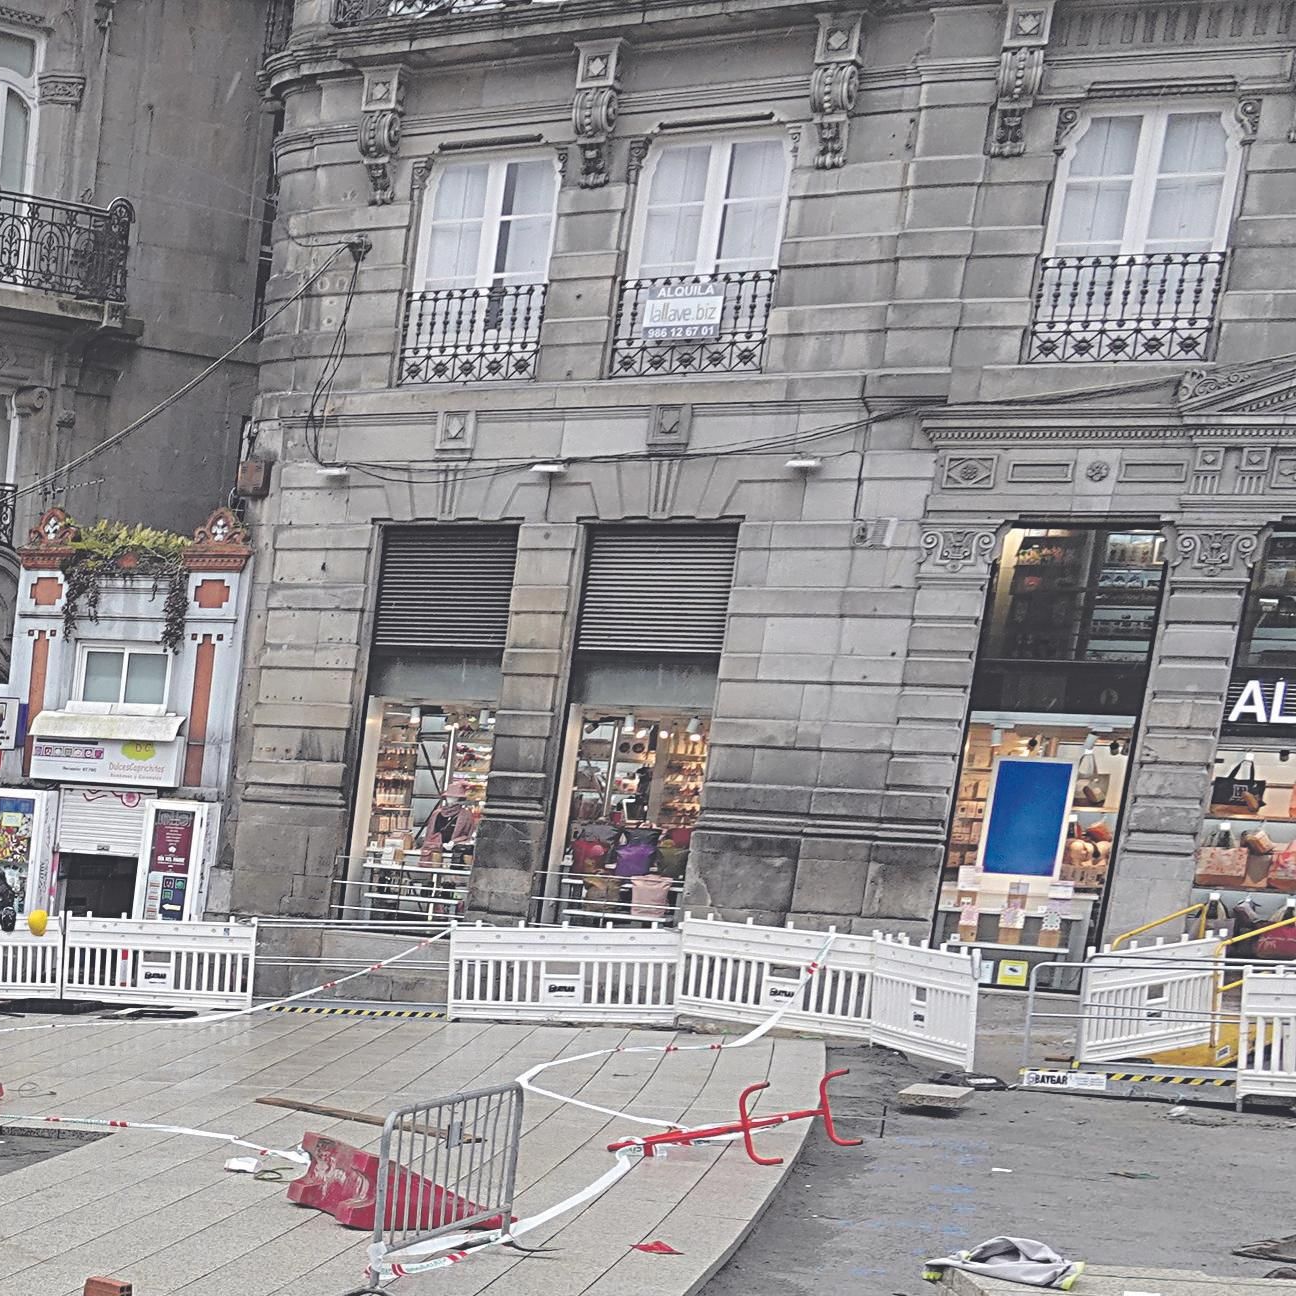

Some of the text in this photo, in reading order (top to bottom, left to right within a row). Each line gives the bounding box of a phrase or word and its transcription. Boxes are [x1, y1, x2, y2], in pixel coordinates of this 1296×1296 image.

[657, 284, 715, 298] ALQUILA
[650, 302, 717, 322] lallave.biz
[648, 326, 714, 338] 986 12 67 01
